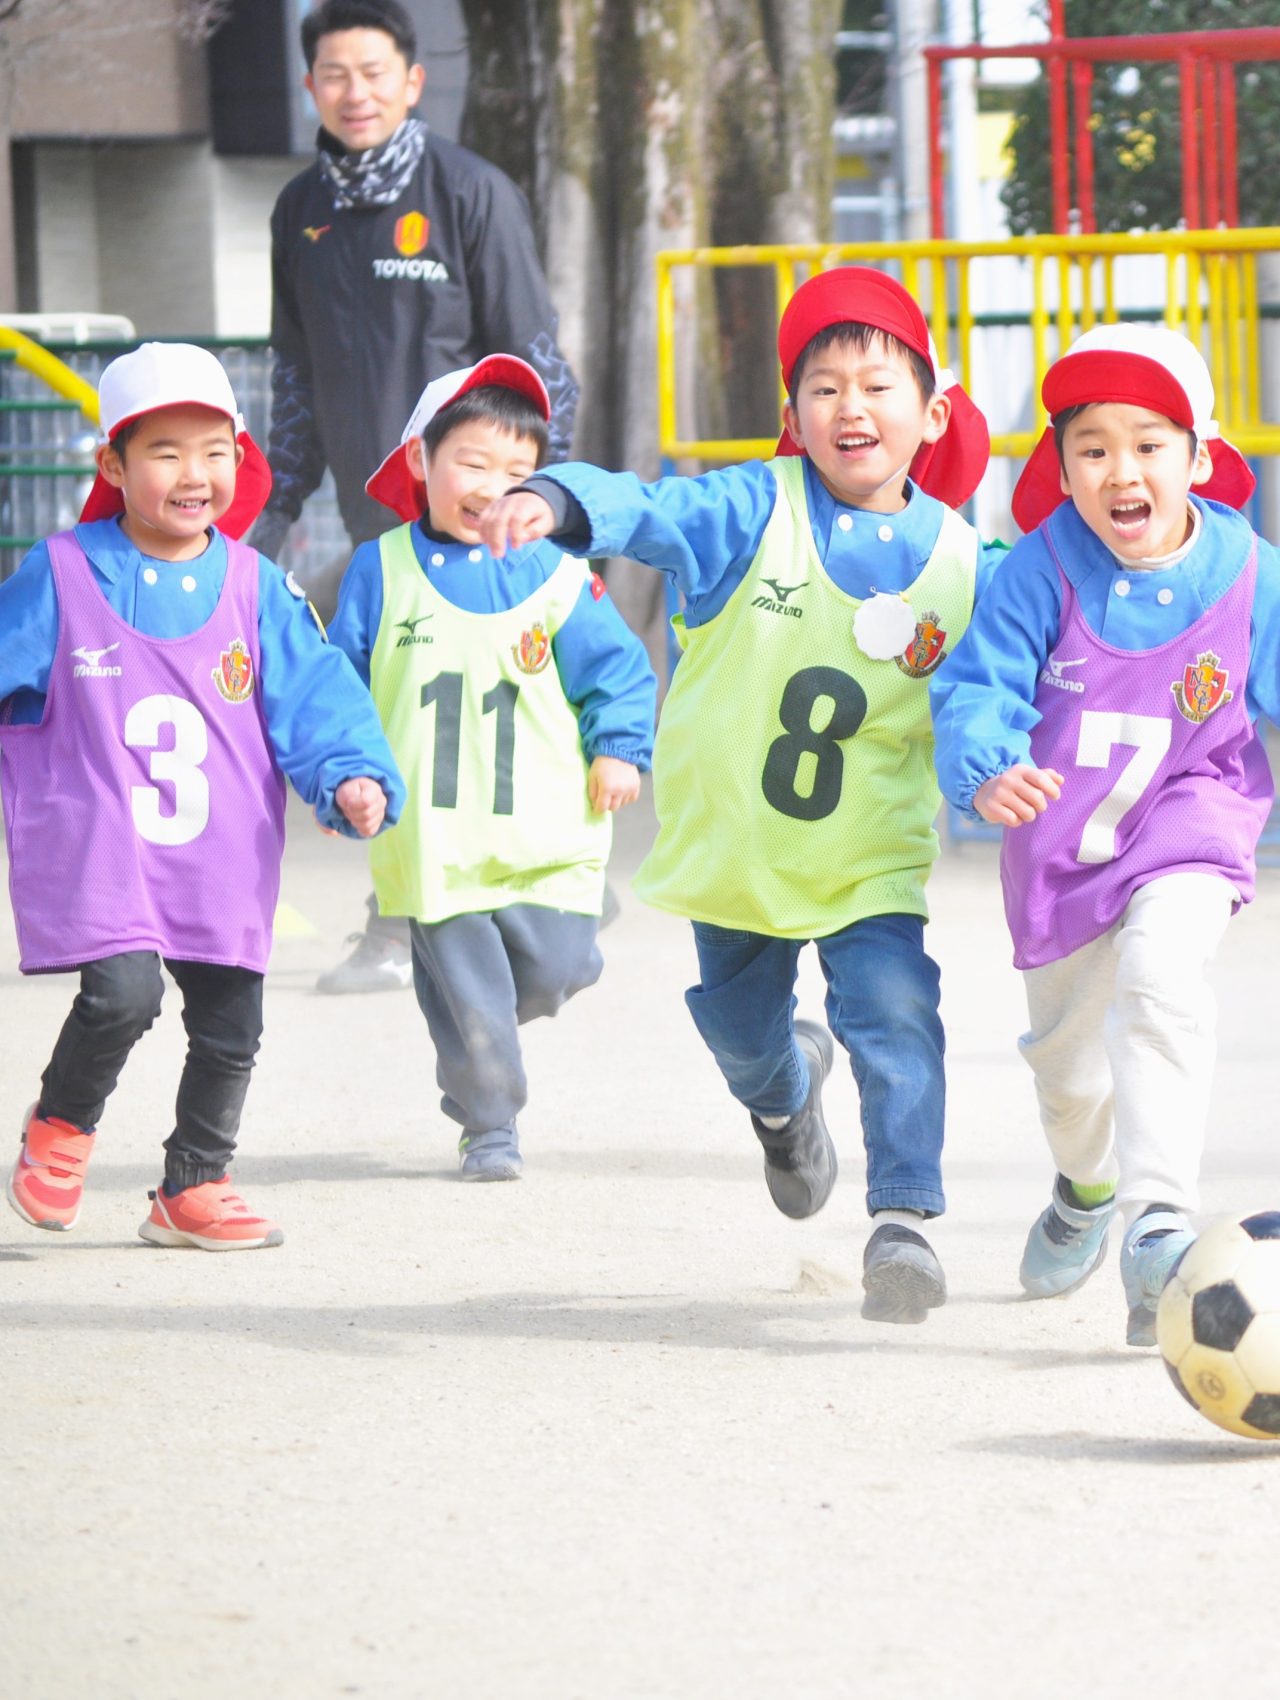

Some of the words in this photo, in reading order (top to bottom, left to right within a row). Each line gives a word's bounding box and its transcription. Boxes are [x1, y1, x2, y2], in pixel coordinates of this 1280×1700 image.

[372, 258, 449, 282] TOYOTA
[124, 693, 210, 846] 3
[420, 670, 520, 815] 11
[761, 665, 868, 822] 8
[1075, 710, 1173, 864] 7
